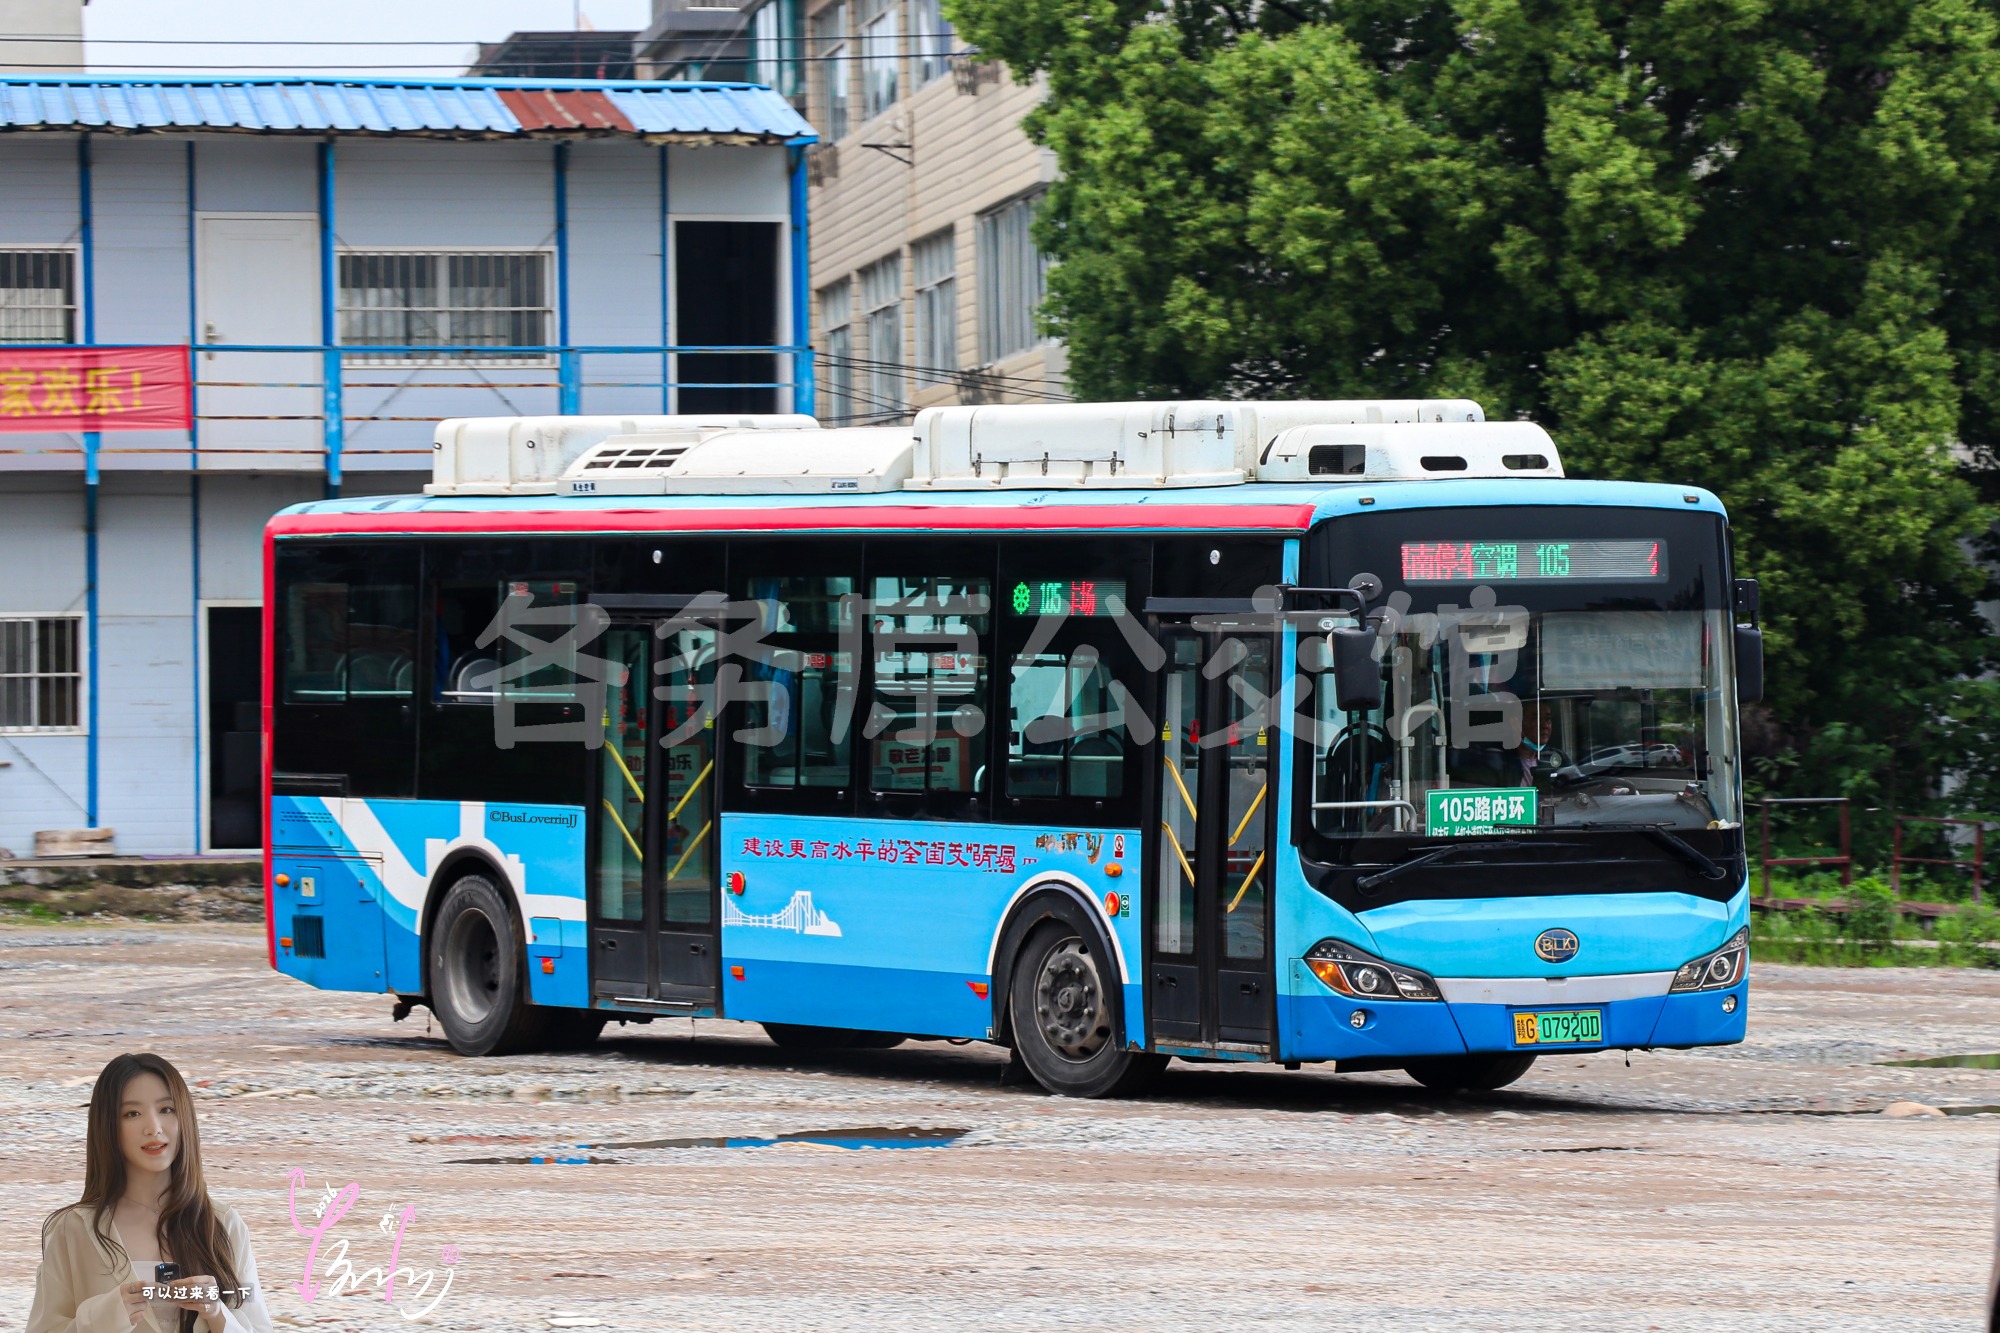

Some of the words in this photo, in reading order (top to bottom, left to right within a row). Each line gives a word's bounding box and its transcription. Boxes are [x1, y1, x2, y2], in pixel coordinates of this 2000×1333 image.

[1471, 543, 1517, 578] 空调
[1536, 544, 1569, 576] 105
[1039, 582, 1062, 614] 105
[1439, 796, 1525, 822] 105路内环
[1542, 938, 1575, 952] BLK
